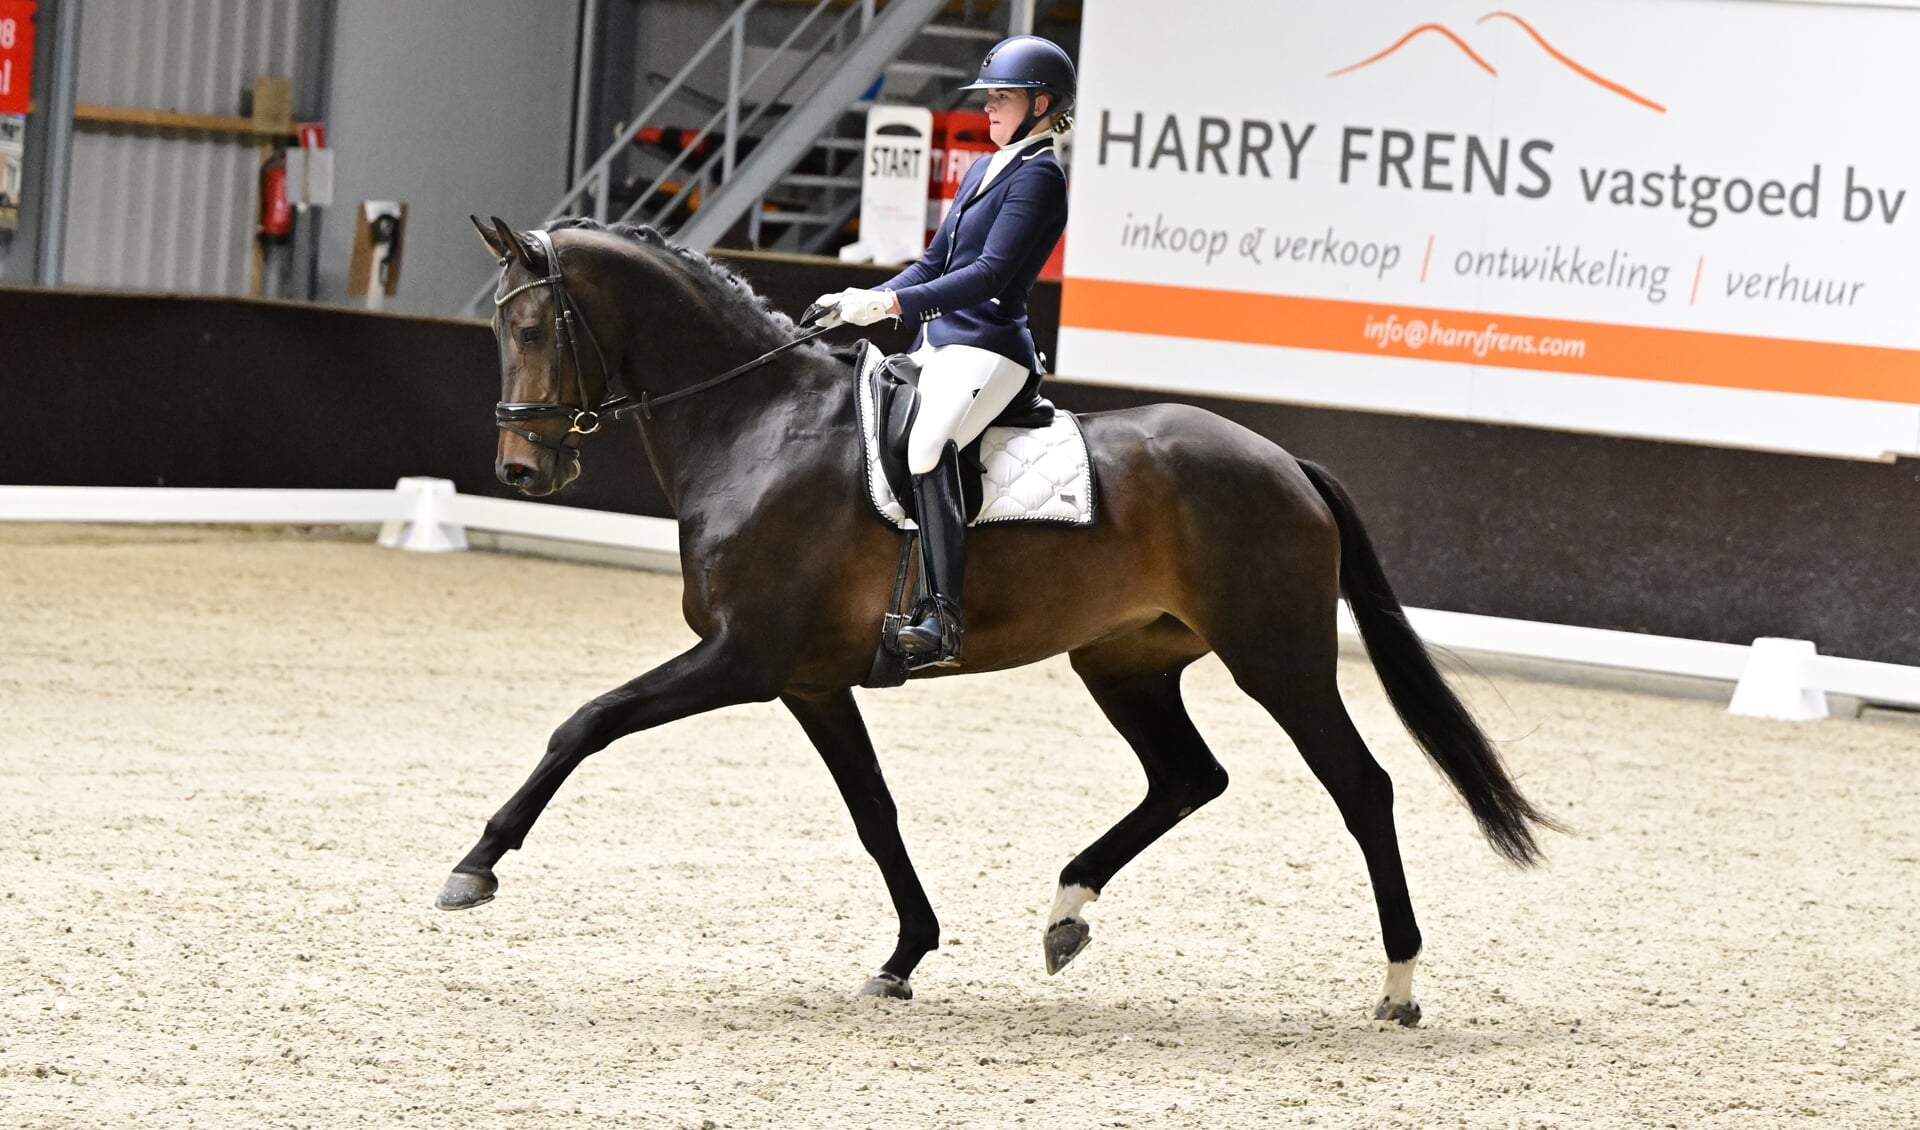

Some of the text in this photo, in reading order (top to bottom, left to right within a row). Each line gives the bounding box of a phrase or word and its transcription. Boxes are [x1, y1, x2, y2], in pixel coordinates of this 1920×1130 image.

[870, 147, 922, 179] START
[1097, 109, 1317, 181] HARRY
[1339, 125, 1555, 200] FRENS
[1579, 163, 1821, 229] vastgoed
[1843, 165, 1907, 225] bv
[1121, 213, 1865, 306] inkoop & verkoop ontwikkeling verhuur
[1363, 313, 1587, 358] info@harryfrens.com
